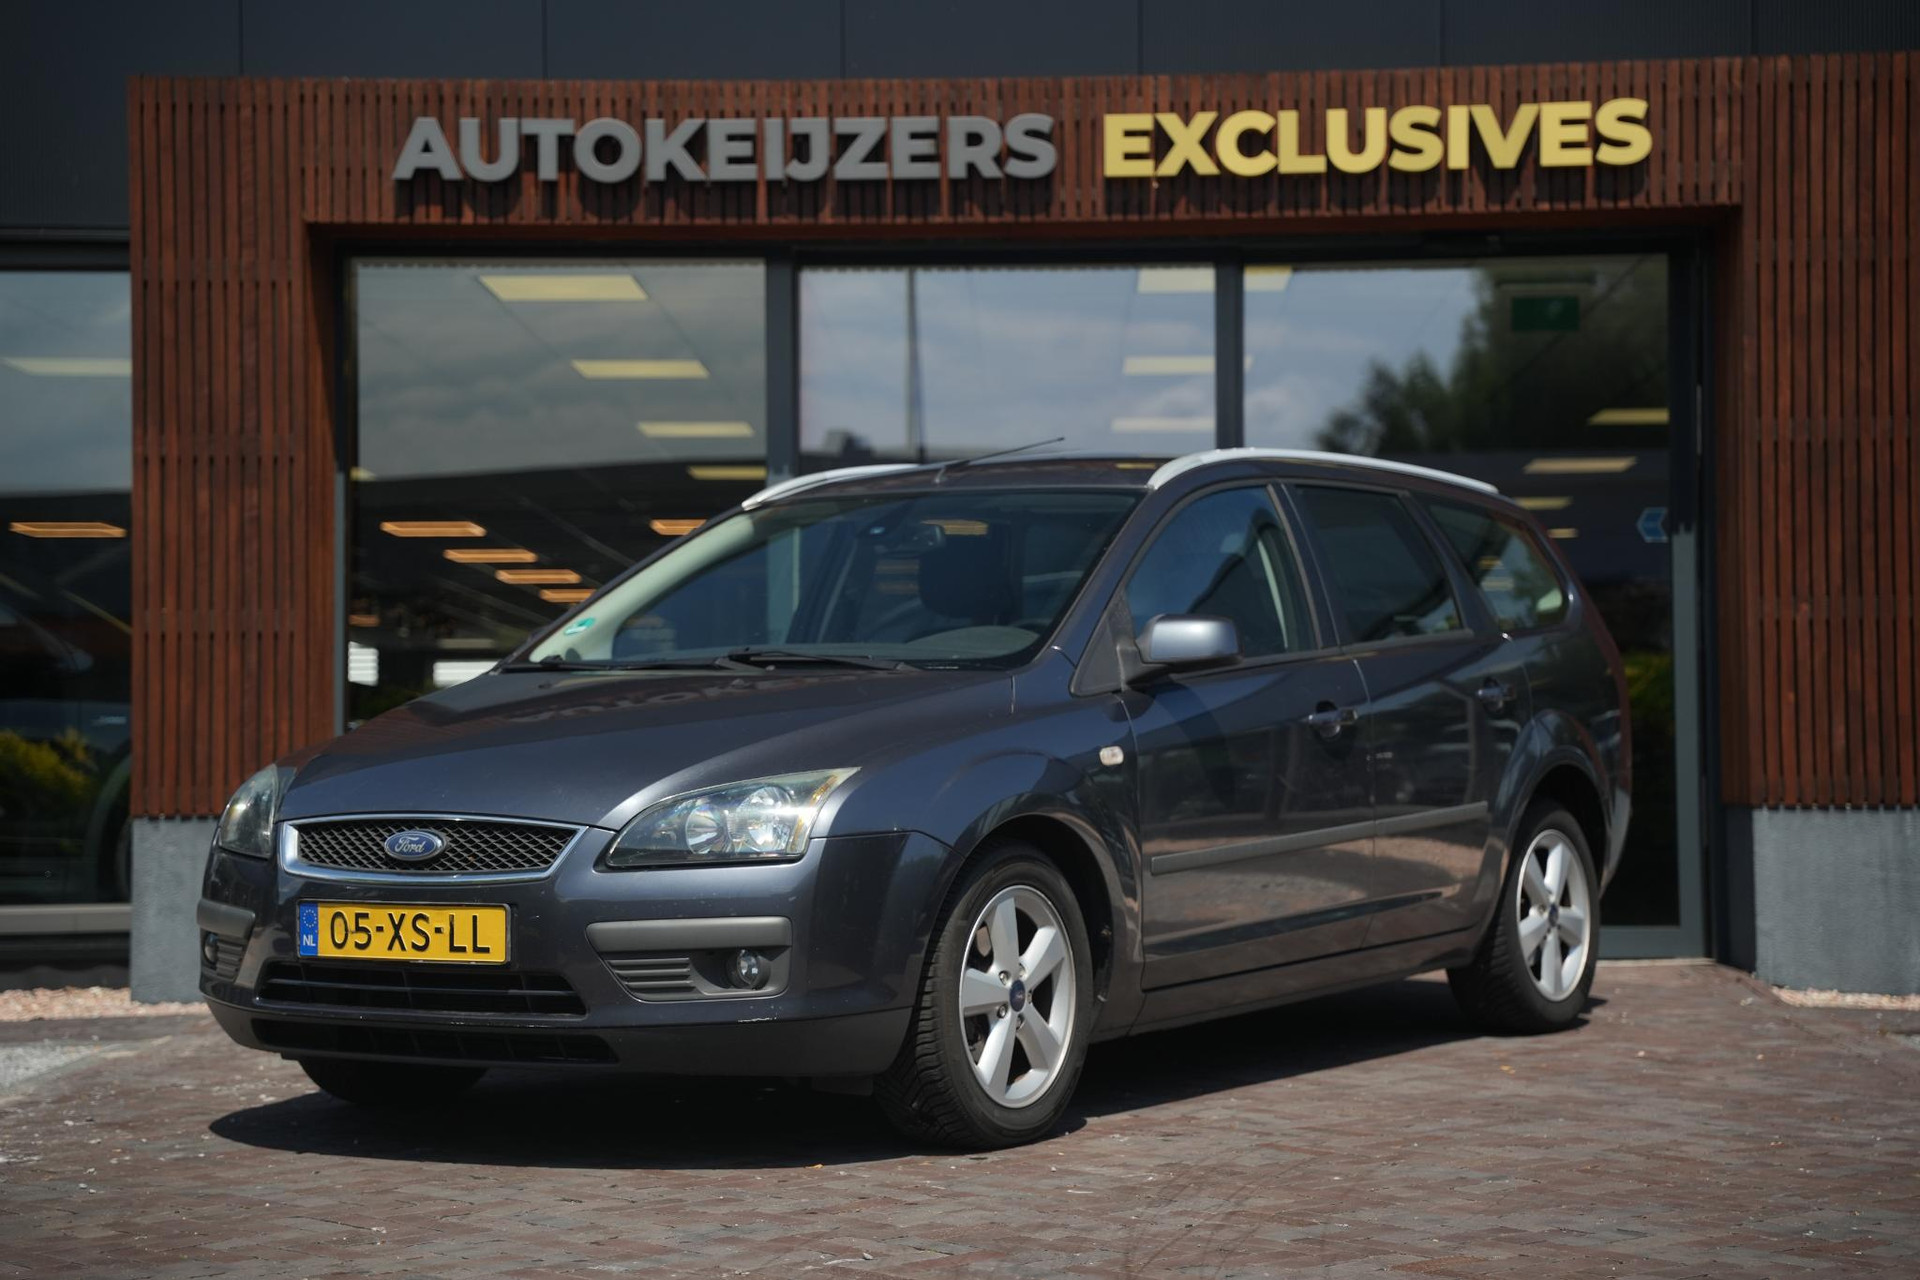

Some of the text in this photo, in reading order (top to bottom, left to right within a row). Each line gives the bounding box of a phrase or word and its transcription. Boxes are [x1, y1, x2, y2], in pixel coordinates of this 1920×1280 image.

[393, 97, 1654, 184] AUTOKEIJZERS EXCLUSIVES
[394, 836, 426, 853] Ford
[302, 934, 317, 947] NL
[330, 910, 491, 954] 05-XS-LL
